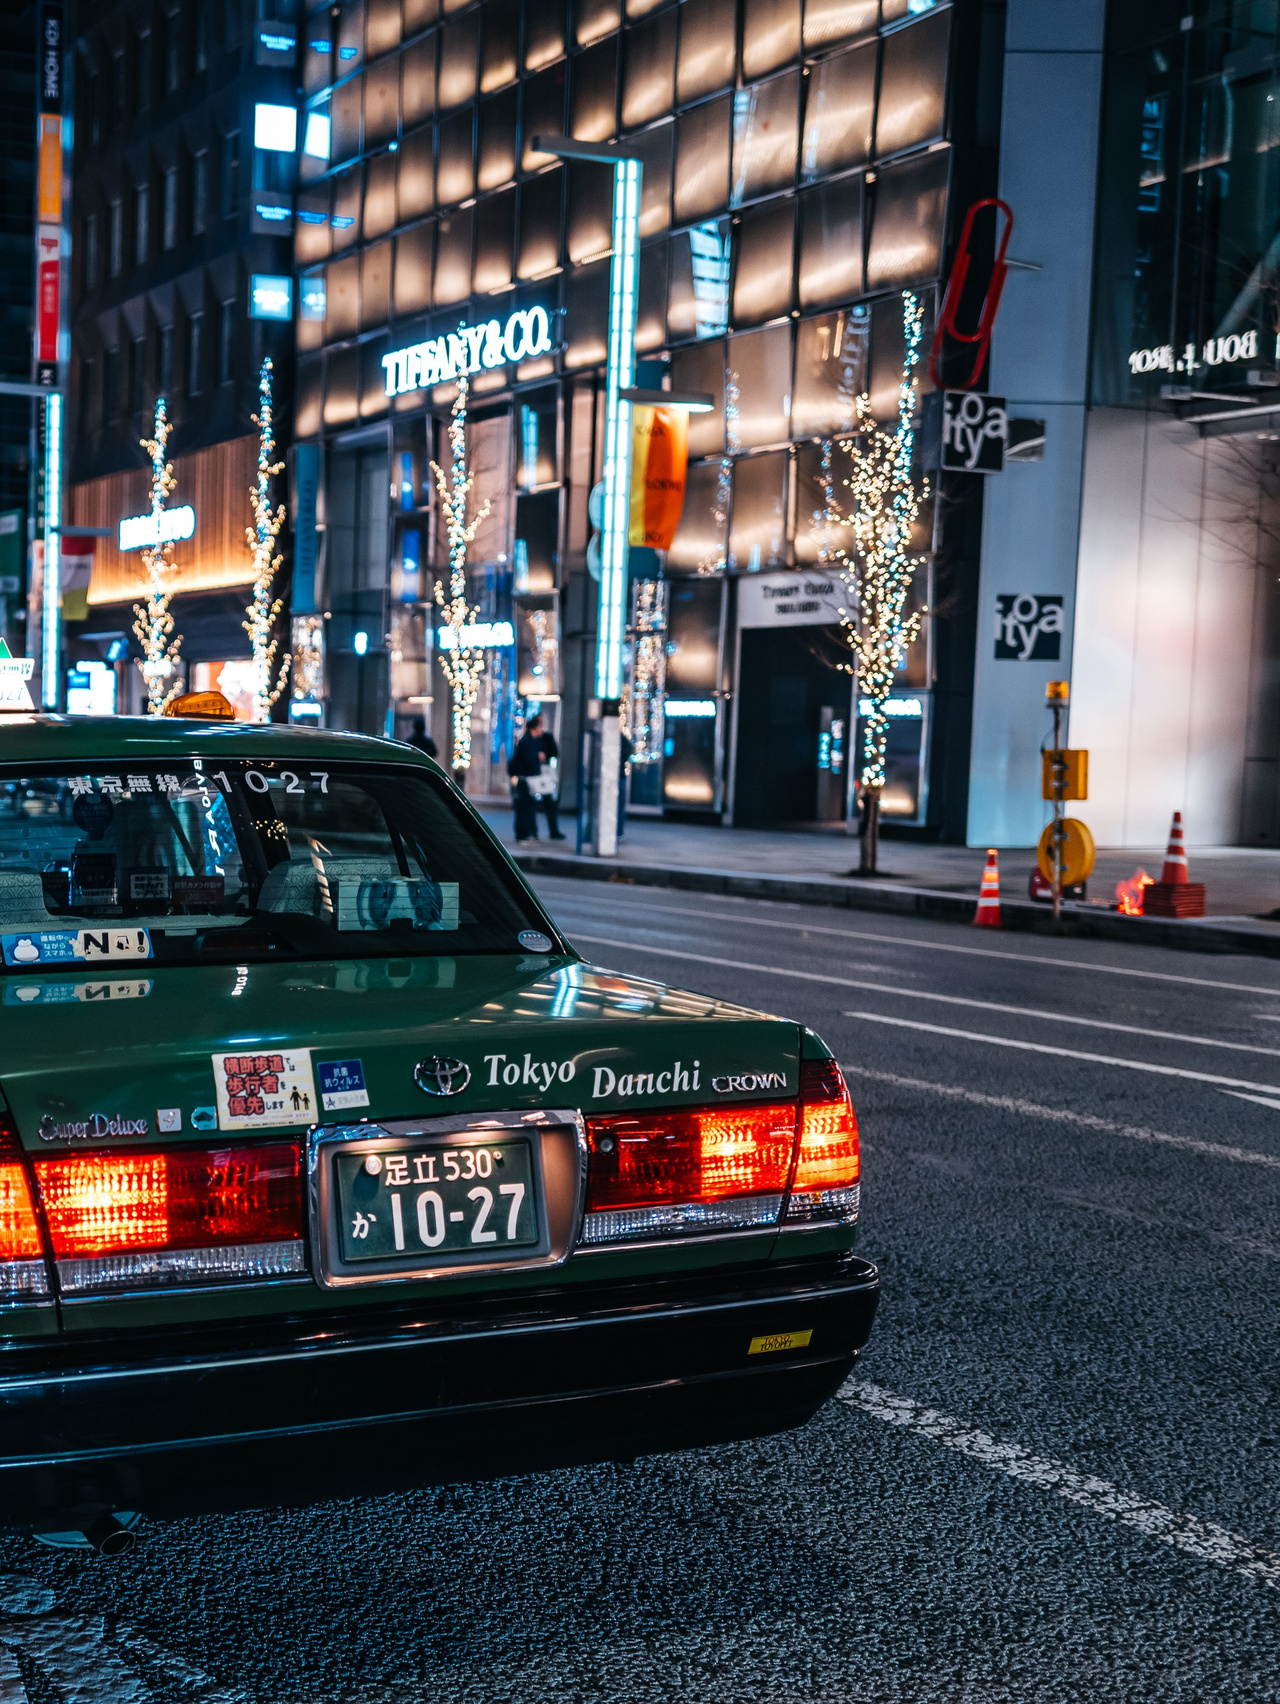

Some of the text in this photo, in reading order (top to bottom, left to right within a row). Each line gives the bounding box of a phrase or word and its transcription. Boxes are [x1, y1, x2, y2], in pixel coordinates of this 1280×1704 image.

[67, 770, 330, 795] 東京無線 1027
[333, 1067, 349, 1077] 抗菌
[483, 1053, 577, 1092] Tokyo
[711, 1072, 787, 1094] CROWN
[226, 1073, 287, 1096] 歩行者を
[228, 1095, 284, 1117] 優先します
[38, 1112, 149, 1145] Super Deluxe
[384, 1149, 493, 1187] 足立 530
[352, 1183, 526, 1251] か 10-27
[760, 1340, 794, 1351] TOYOPET
[764, 1334, 791, 1344] TOKYO
